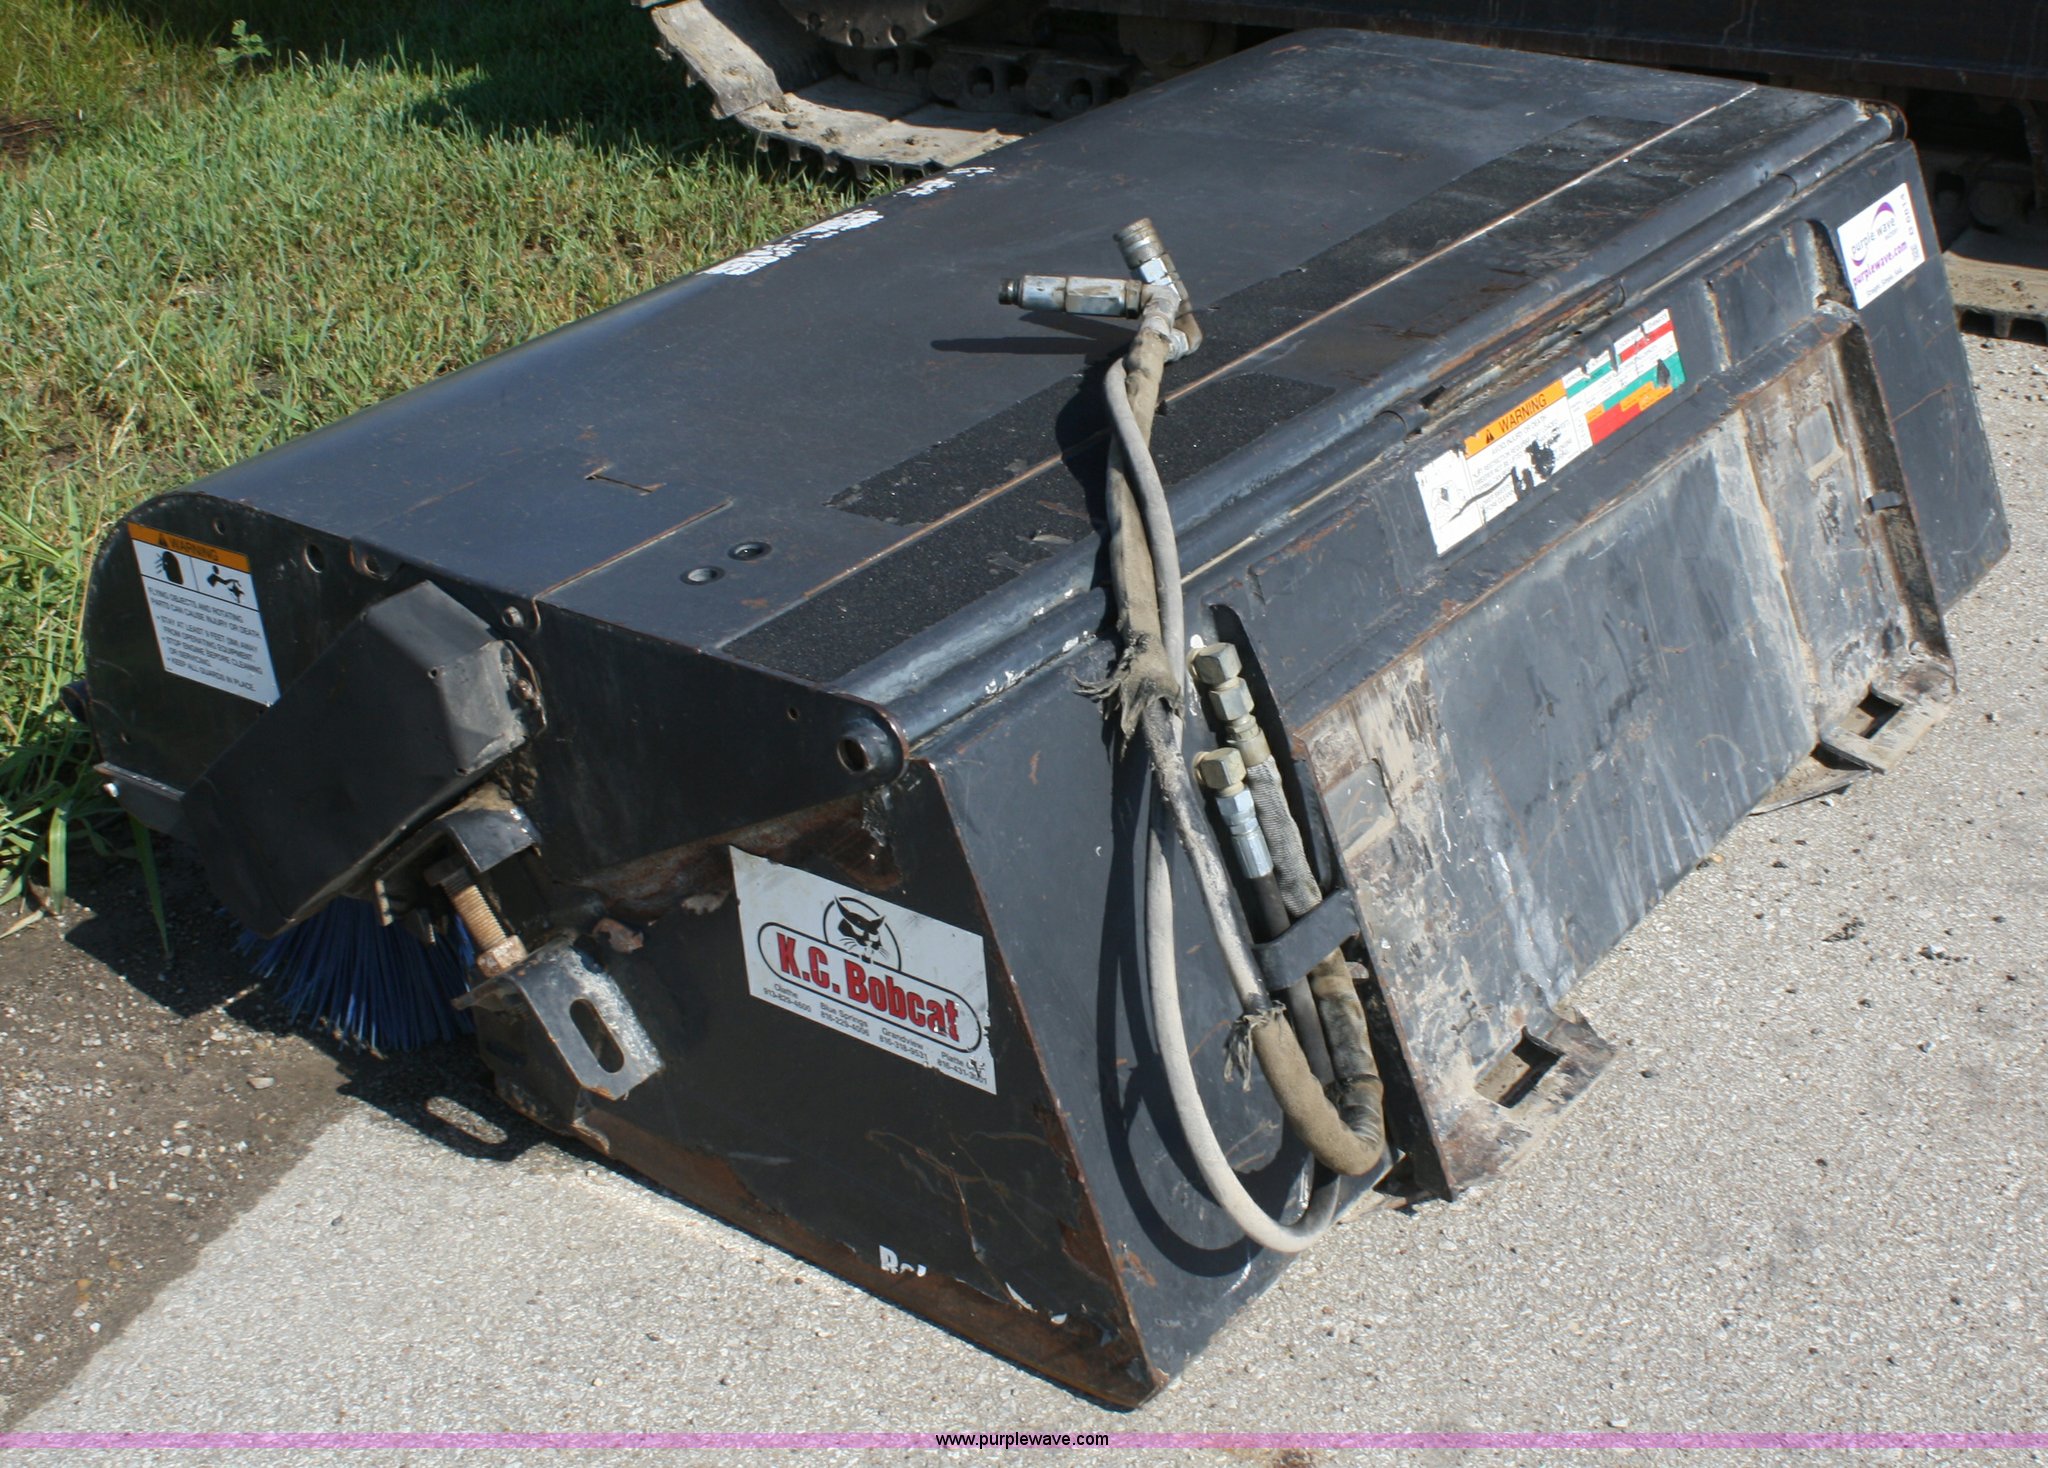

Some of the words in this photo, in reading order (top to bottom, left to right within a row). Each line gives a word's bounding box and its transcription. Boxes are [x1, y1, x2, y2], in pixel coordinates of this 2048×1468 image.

[1850, 231, 1875, 256] purple
[1876, 218, 1895, 237] wave
[1853, 241, 1907, 290] purplewave.com
[1498, 392, 1547, 434] WARNING
[169, 539, 218, 561] WARNING
[169, 593, 196, 608] OBJECTS
[161, 616, 175, 626] STAY
[185, 623, 203, 635] LEAST
[210, 631, 224, 642] FEET
[170, 604, 183, 614] CAN
[184, 608, 204, 621] CAUSE
[206, 615, 226, 627] INJURY
[229, 622, 237, 631] OR
[164, 626, 180, 637] FROM
[181, 632, 215, 649] OPERATING
[166, 637, 181, 647] STOP
[183, 642, 204, 655] ENGINE
[206, 650, 230, 664] BEFORE
[231, 658, 262, 675] CLEANING
[169, 647, 177, 656] OR
[172, 658, 185, 668] KEEP
[187, 663, 198, 672] ALL
[200, 667, 224, 681] GUARDS
[773, 983, 798, 1000] Olathe
[776, 932, 841, 994] K.C.
[843, 958, 960, 1042] Bobcat
[819, 1001, 837, 1016] Blue
[838, 1009, 868, 1030] Springs
[881, 1026, 923, 1050] Grandview
[940, 1050, 964, 1067] Platte
